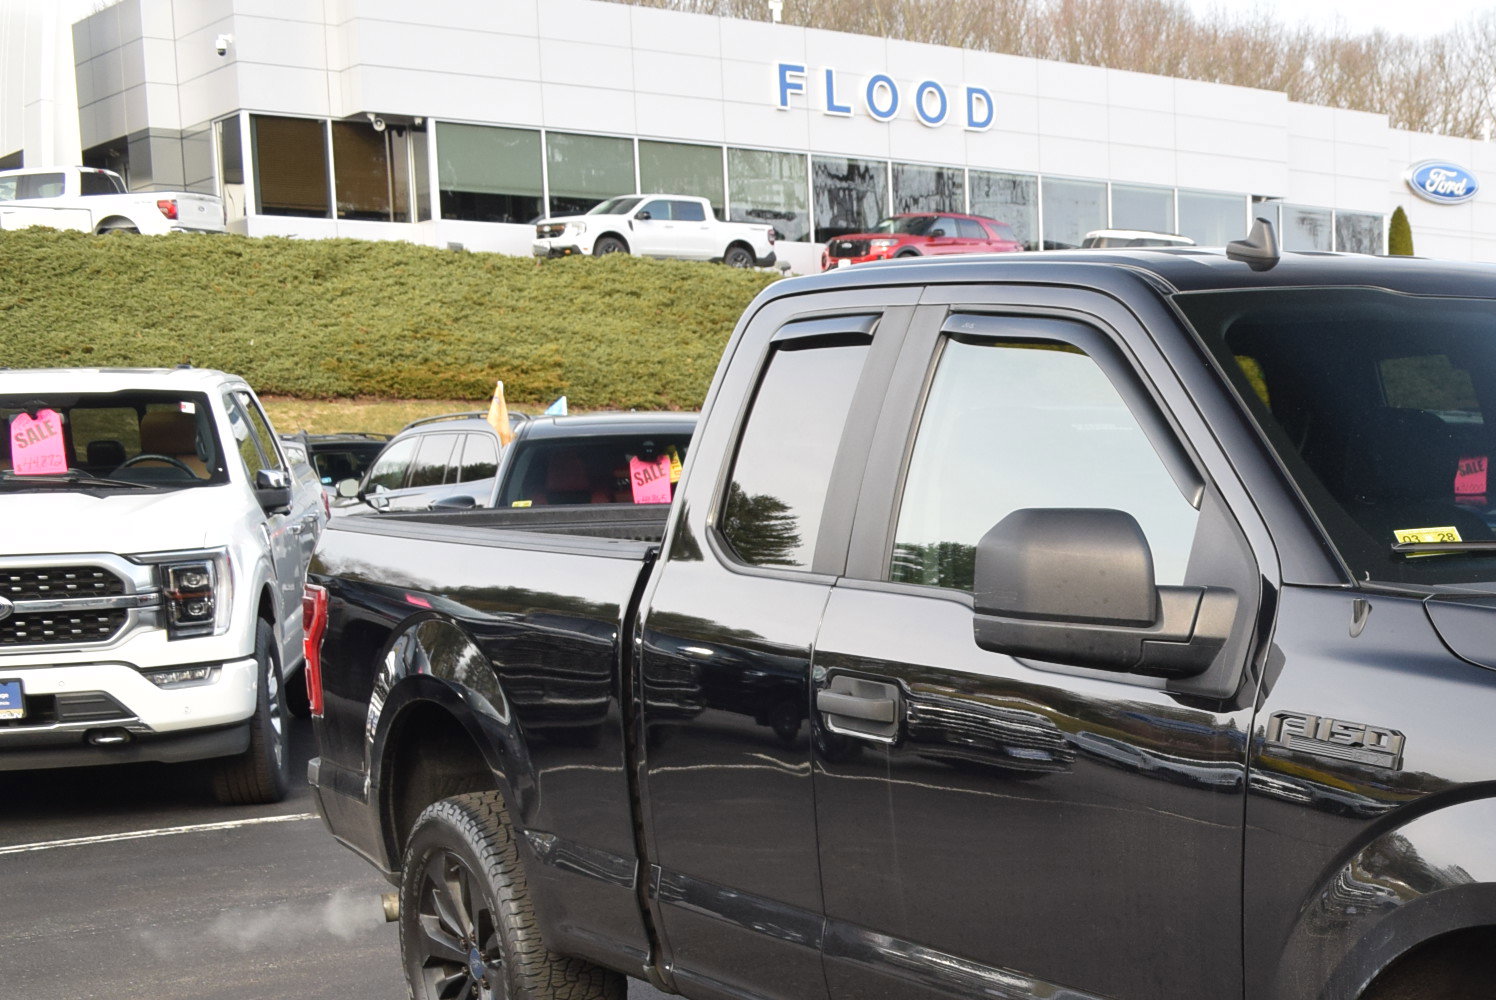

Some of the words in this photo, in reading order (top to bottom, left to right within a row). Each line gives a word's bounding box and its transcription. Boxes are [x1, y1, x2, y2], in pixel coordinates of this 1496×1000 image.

[776, 62, 996, 130] FLOOD
[1425, 168, 1467, 195] Ford
[15, 420, 57, 449] SALE
[634, 462, 666, 487] SALE
[1458, 460, 1484, 477] SALE
